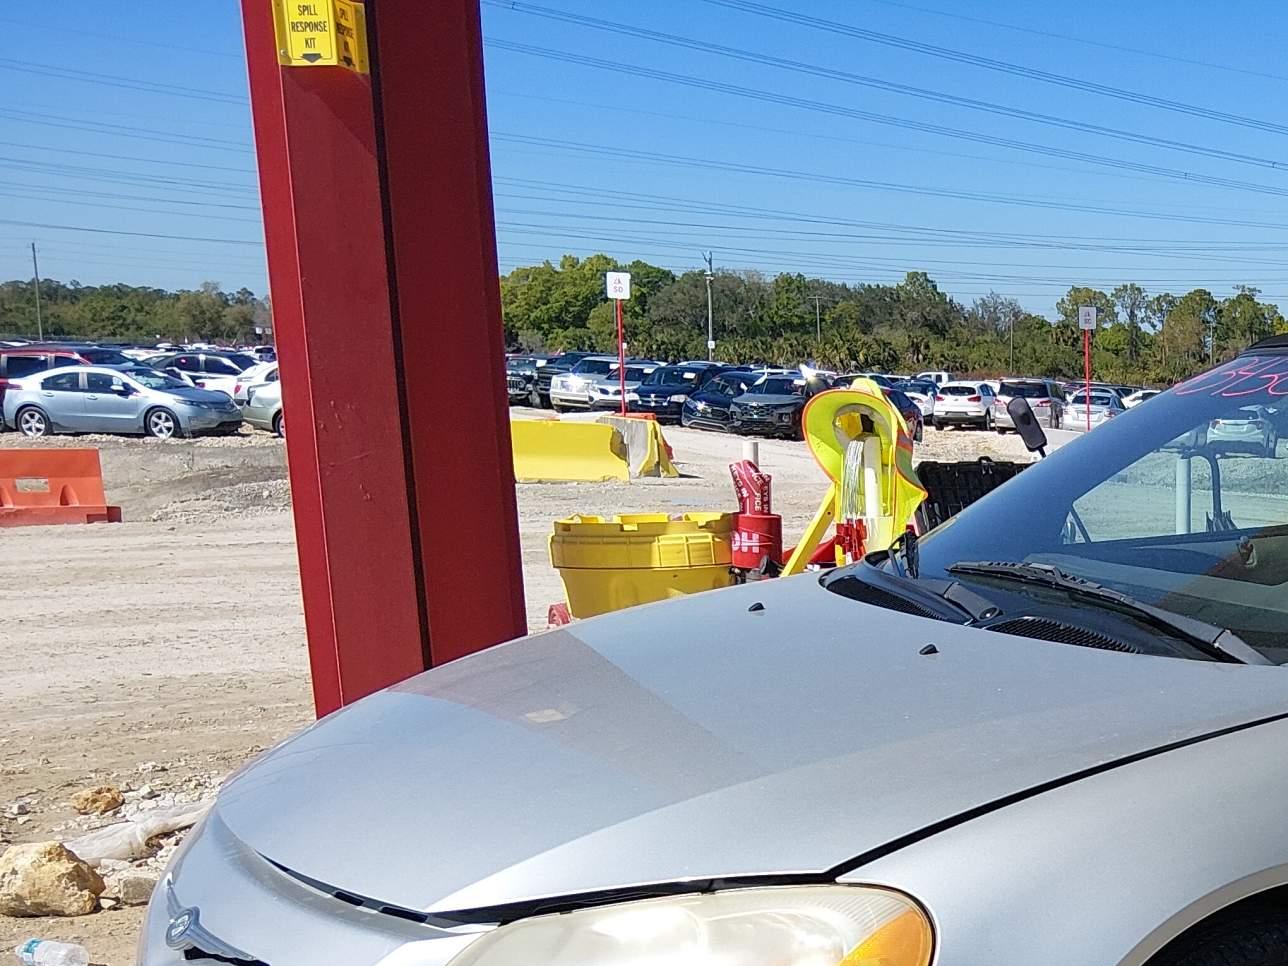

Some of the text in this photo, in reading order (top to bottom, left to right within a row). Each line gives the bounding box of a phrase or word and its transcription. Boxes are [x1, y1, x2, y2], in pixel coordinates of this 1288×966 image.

[297, 4, 318, 16] SPILL
[290, 21, 328, 33] RESPONSE
[304, 37, 316, 49] KIT
